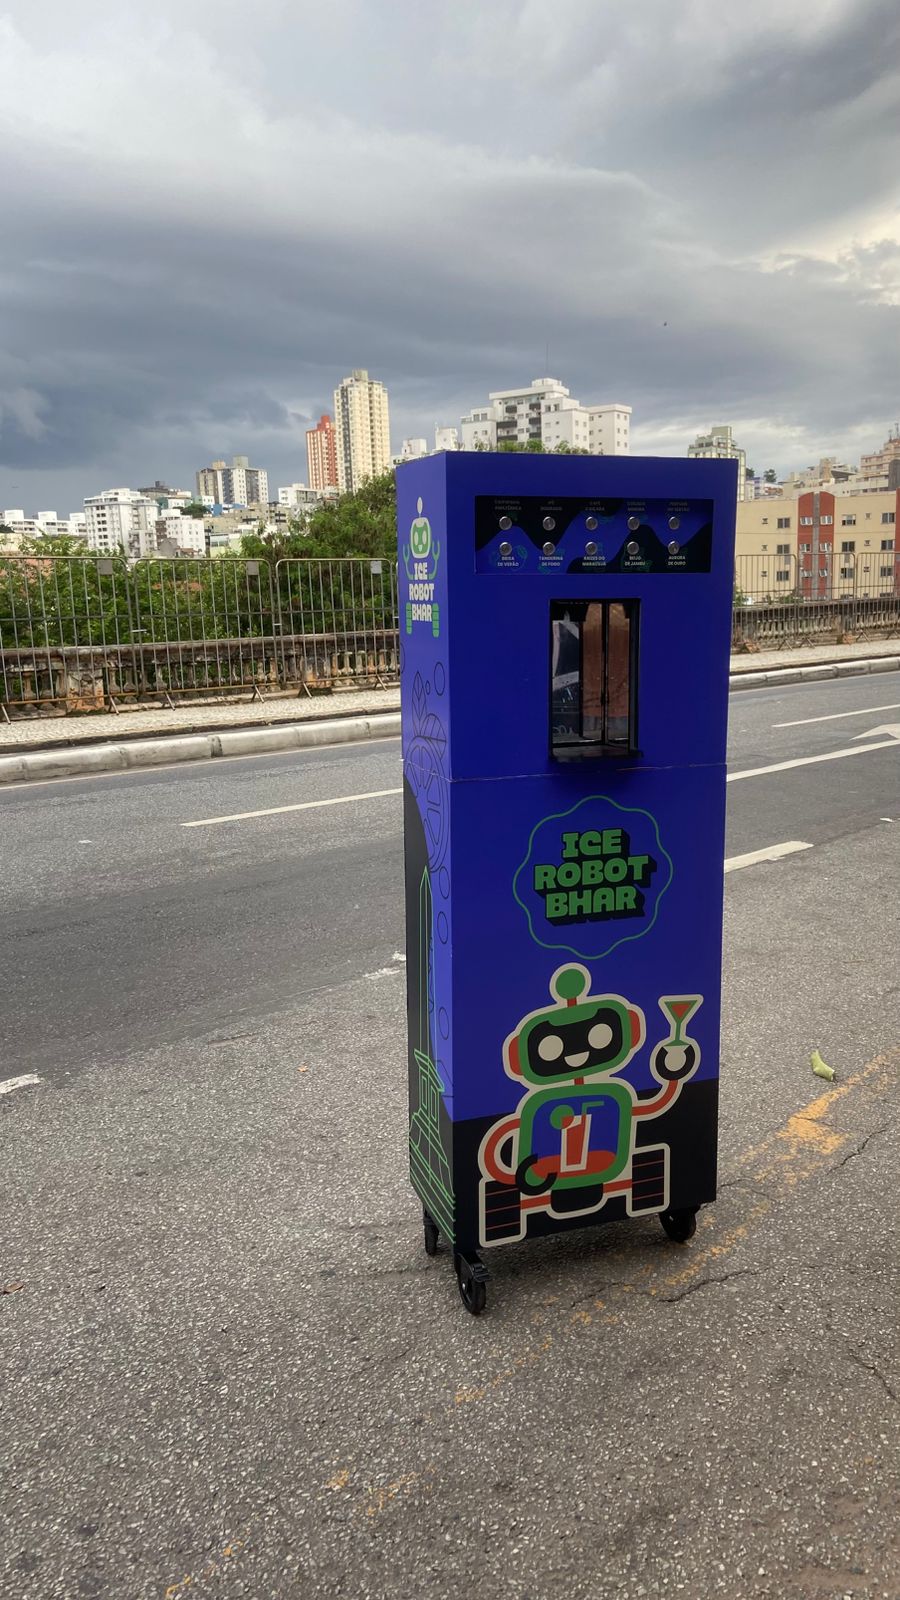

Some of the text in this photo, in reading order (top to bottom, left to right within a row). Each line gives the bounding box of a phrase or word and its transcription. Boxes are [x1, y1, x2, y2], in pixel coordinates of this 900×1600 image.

[414, 562, 428, 580] ICE
[409, 583, 434, 601] ROBOT
[411, 603, 432, 622] BHAR
[562, 829, 622, 858] ICE
[534, 855, 649, 890] ROBOT
[546, 885, 637, 918] BHAR
